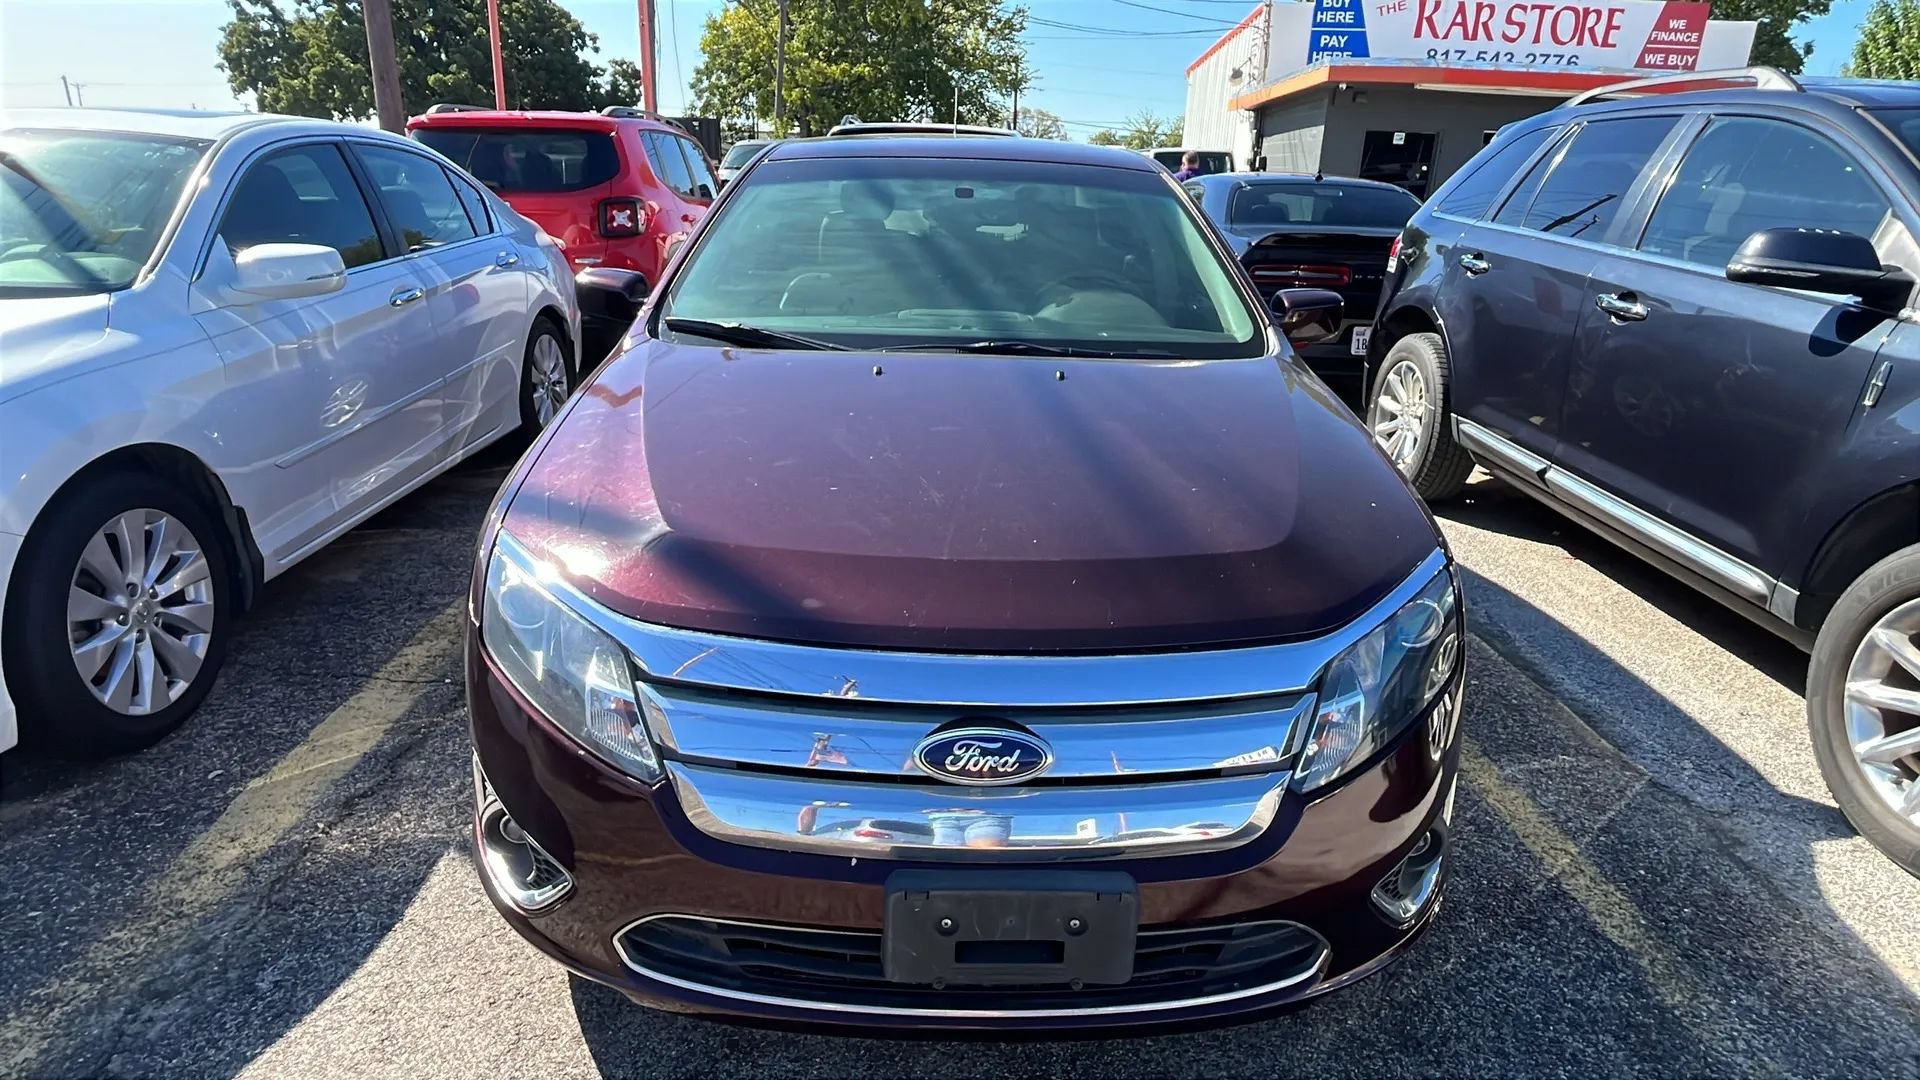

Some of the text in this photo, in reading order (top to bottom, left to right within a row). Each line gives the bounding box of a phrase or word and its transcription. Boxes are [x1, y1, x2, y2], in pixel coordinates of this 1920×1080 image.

[1323, 0, 1350, 8] BUY
[1316, 11, 1354, 23] HERE
[1376, 0, 1625, 48] THE KAR STORE
[1669, 19, 1687, 29] WE
[1320, 35, 1348, 48] PAY
[1651, 31, 1699, 42] FINANCE
[1645, 54, 1696, 66] WE BUY
[945, 740, 1020, 772] Ford
